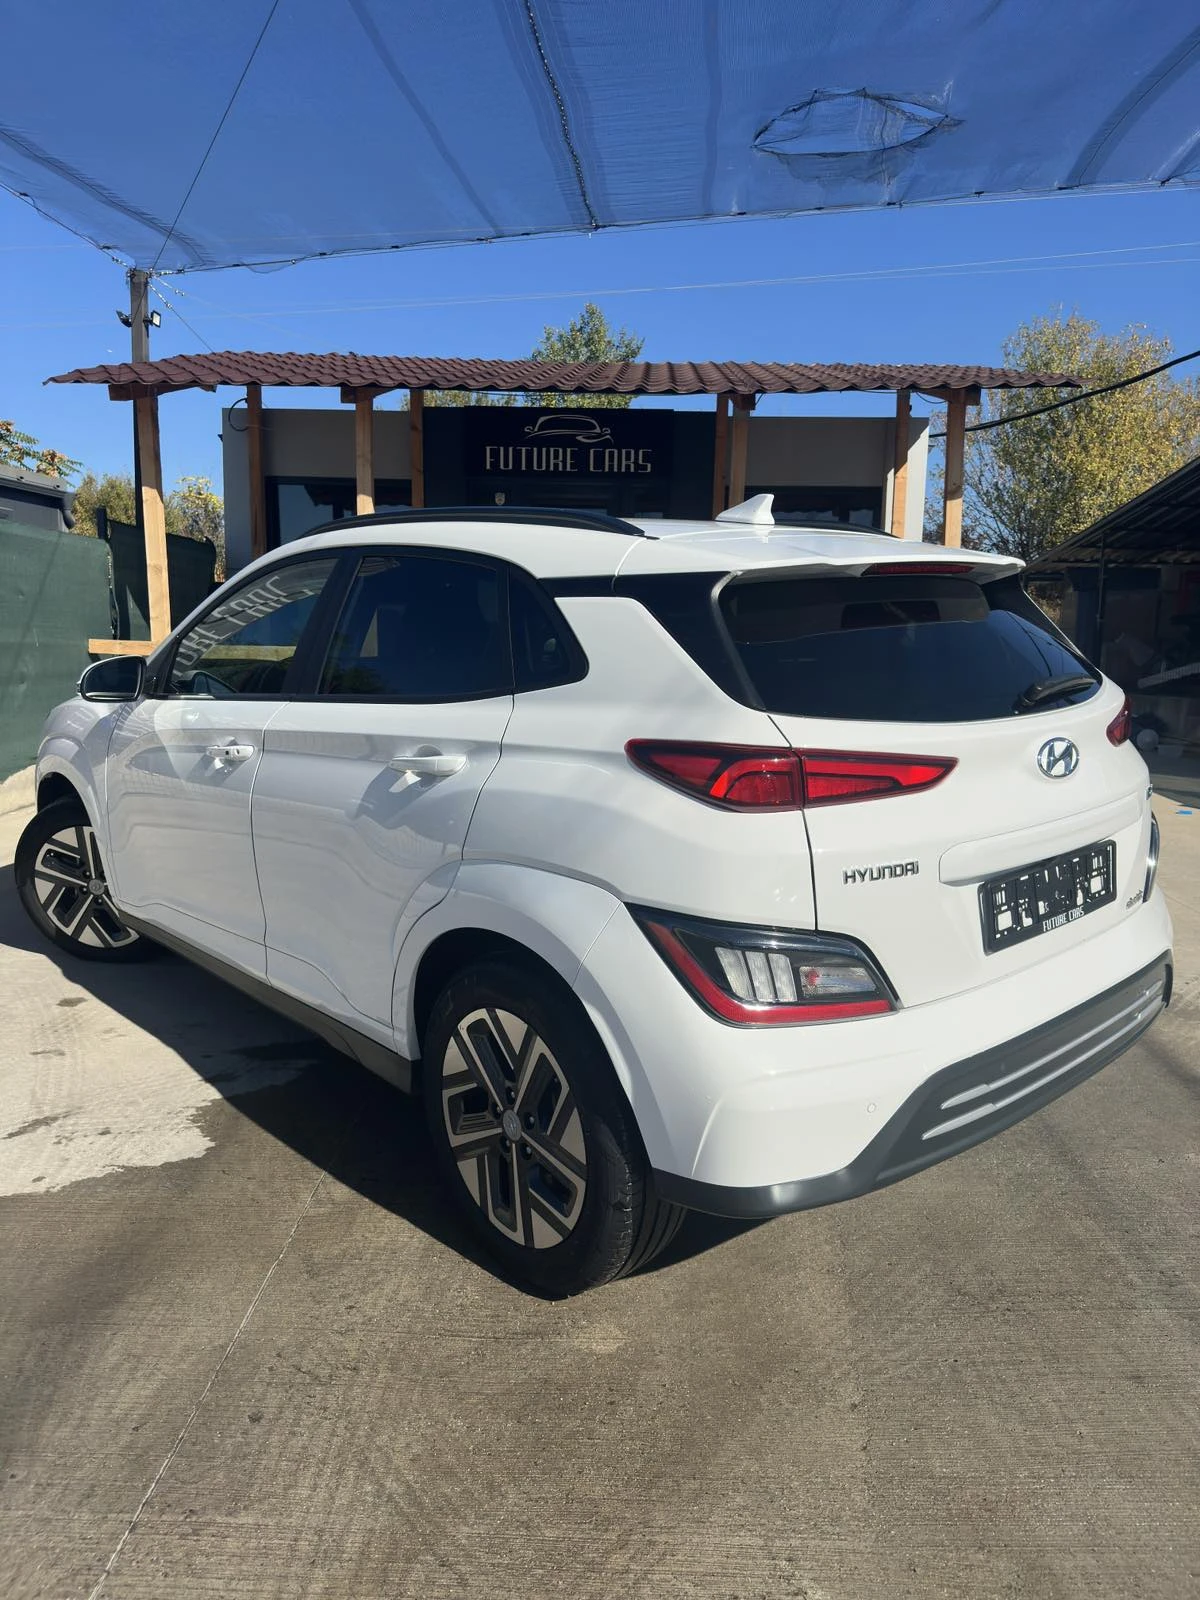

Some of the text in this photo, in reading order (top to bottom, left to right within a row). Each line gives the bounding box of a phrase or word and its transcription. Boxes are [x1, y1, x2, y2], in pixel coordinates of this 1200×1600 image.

[485, 445, 653, 474] FUTURE CARS
[842, 860, 920, 886] HYUNDAI
[1042, 904, 1085, 933] FUTURE CARS
